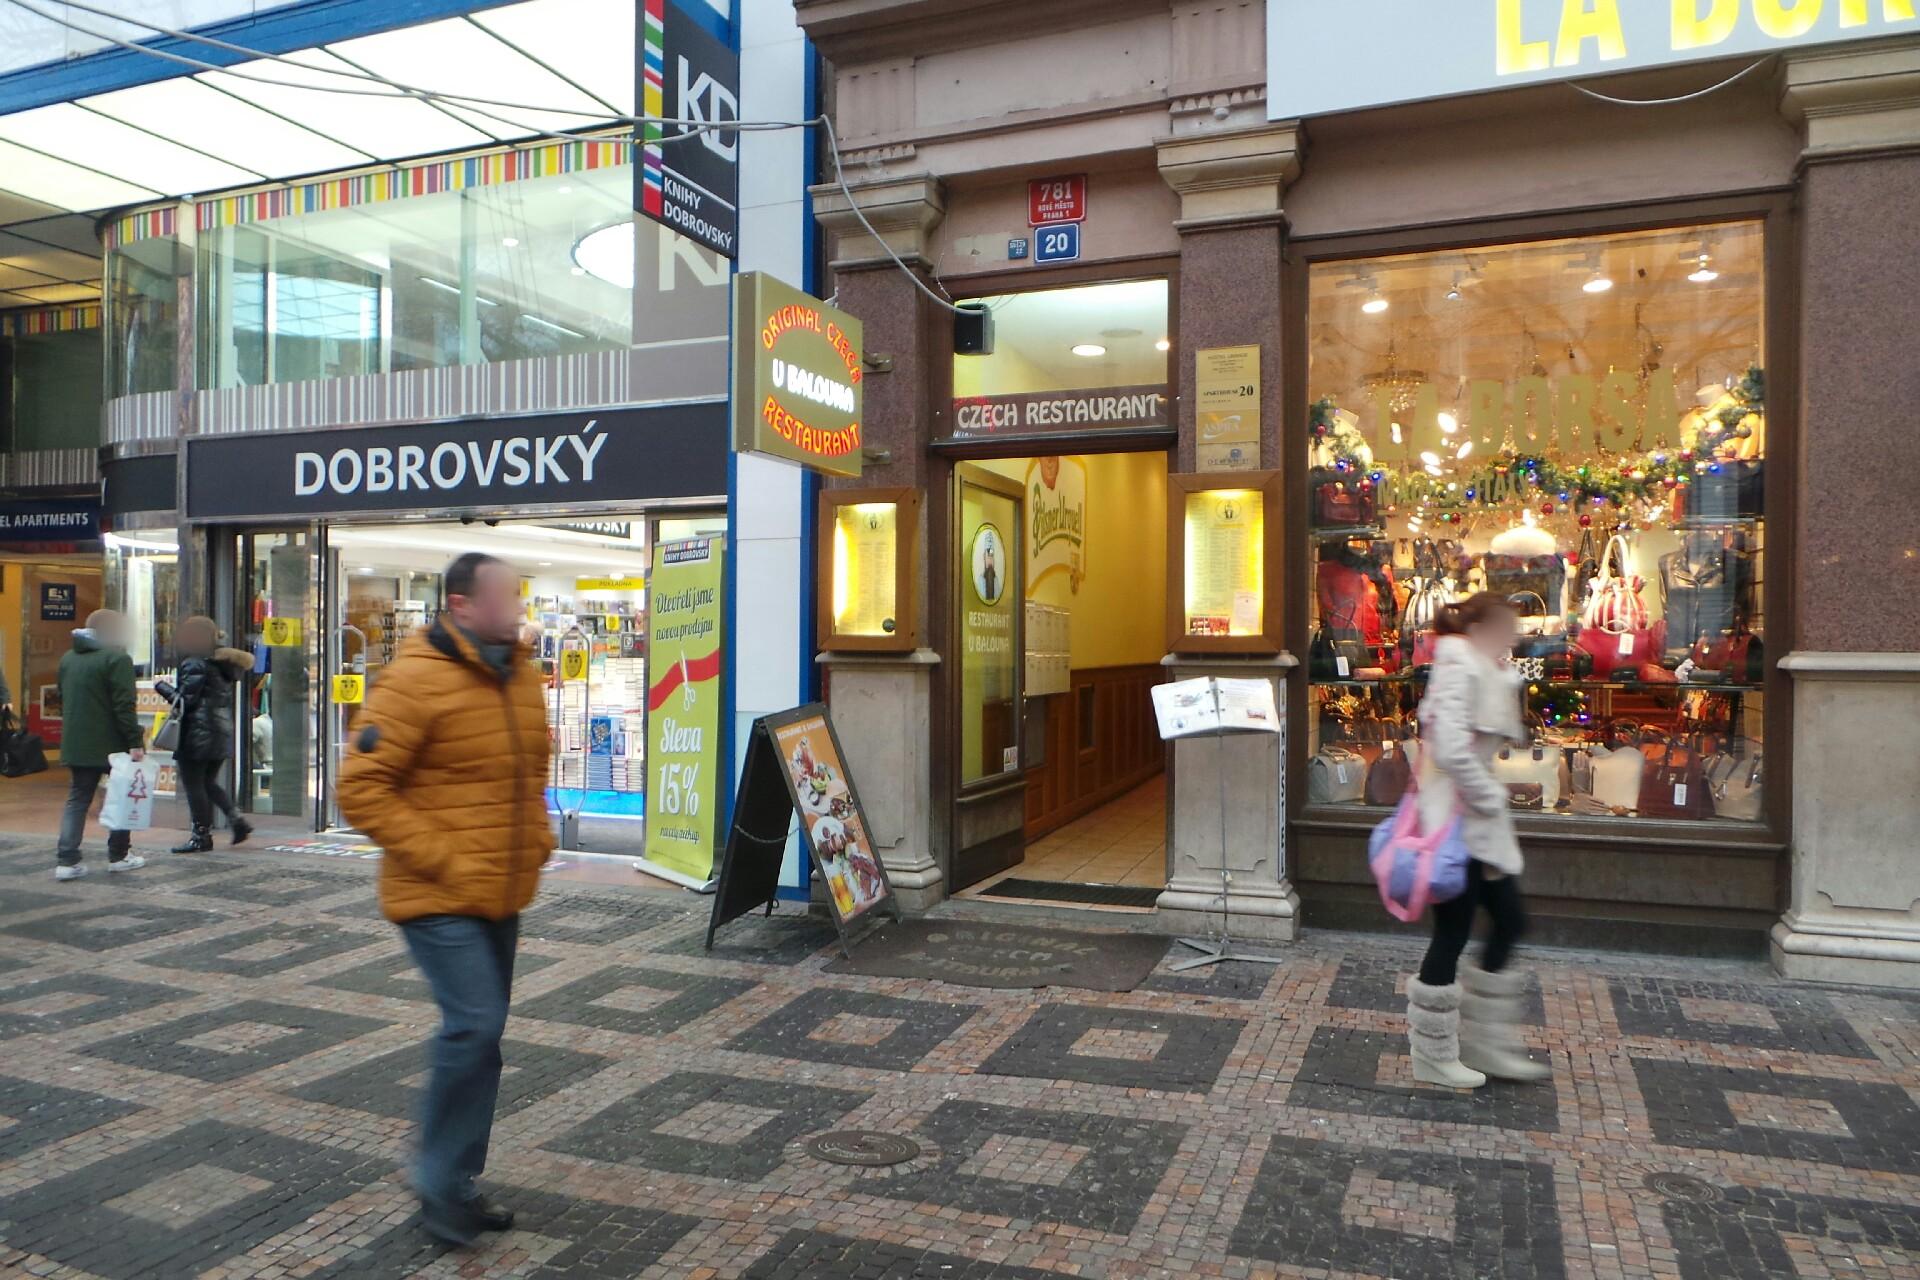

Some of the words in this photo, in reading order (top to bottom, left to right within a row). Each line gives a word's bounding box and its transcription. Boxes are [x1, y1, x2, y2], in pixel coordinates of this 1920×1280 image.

[663, 176, 701, 210] KNIHY
[1040, 181, 1072, 202] 781
[663, 201, 733, 249] DOBROVSKÝ
[1045, 233, 1068, 253] 20
[762, 304, 822, 350] ORIGINAL
[826, 321, 862, 384] CZECH
[772, 358, 785, 388] U
[1240, 385, 1254, 397] 20
[763, 395, 861, 457] RESTAURANT
[957, 403, 1017, 428] CZECH
[1026, 393, 1160, 425] RESTAURANT
[1471, 368, 1682, 456] BORSA
[295, 420, 608, 496] DOBROVSKÝ
[14, 512, 89, 527] APARTMENTS
[664, 551, 680, 562] KNIHY
[691, 587, 714, 613] jsme
[969, 611, 1010, 629] RESTAURANT
[660, 717, 702, 753] Sleva
[659, 762, 699, 816] 15%
